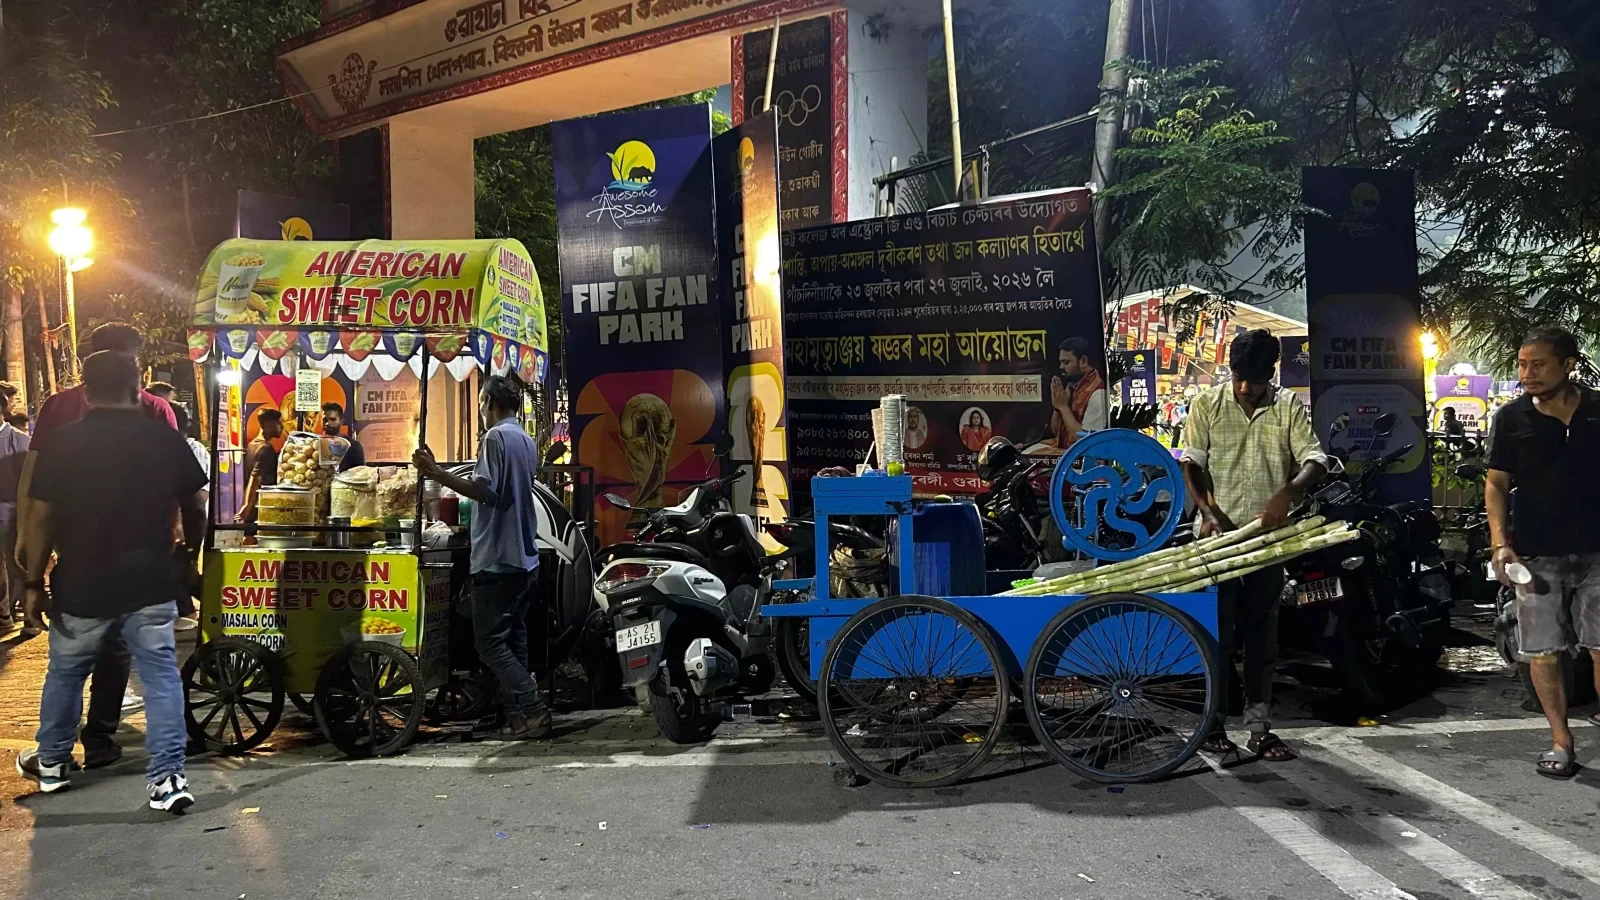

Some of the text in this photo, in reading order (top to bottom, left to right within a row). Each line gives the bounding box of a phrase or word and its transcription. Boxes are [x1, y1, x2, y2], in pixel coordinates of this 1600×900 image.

[591, 186, 658, 204] Awesome
[586, 195, 668, 230] Assam
[1016, 198, 1078, 219] উদ্যোগত
[924, 241, 949, 263] তথা
[952, 240, 973, 261] জন
[1032, 220, 1087, 257] হিতাৰ্থে
[306, 252, 466, 278] AMERICAN
[498, 247, 533, 285] AMERICAN
[612, 244, 661, 277] CM
[499, 275, 532, 305] SWEET CORN
[845, 283, 861, 299] ২৩
[928, 277, 947, 295] ২৭
[948, 269, 988, 297] জুলাই,
[991, 272, 1031, 291] ২০২৬
[1033, 266, 1055, 288] লৈ
[572, 275, 708, 314] FIFA FAN
[278, 286, 475, 326] SWEET CORN
[599, 311, 684, 345] PARK
[731, 319, 772, 354] PARK
[917, 329, 950, 366] মহা
[955, 326, 1047, 363] আয়োজন
[1331, 337, 1397, 352] CM FIFA
[1323, 355, 1406, 369] FAN PARK
[1014, 377, 1038, 395] থাকিব
[1130, 388, 1148, 396] FIFA
[1132, 379, 1146, 387] CM
[367, 391, 406, 401] CM FIFA
[362, 402, 413, 413] FAN PARK
[239, 560, 390, 582] AMERICAN
[221, 586, 408, 611] SWEET CORN
[221, 613, 287, 628] MASALA CORN
[627, 623, 656, 637] AS 21
[260, 635, 286, 649] CORN
[627, 633, 656, 649] J4155
